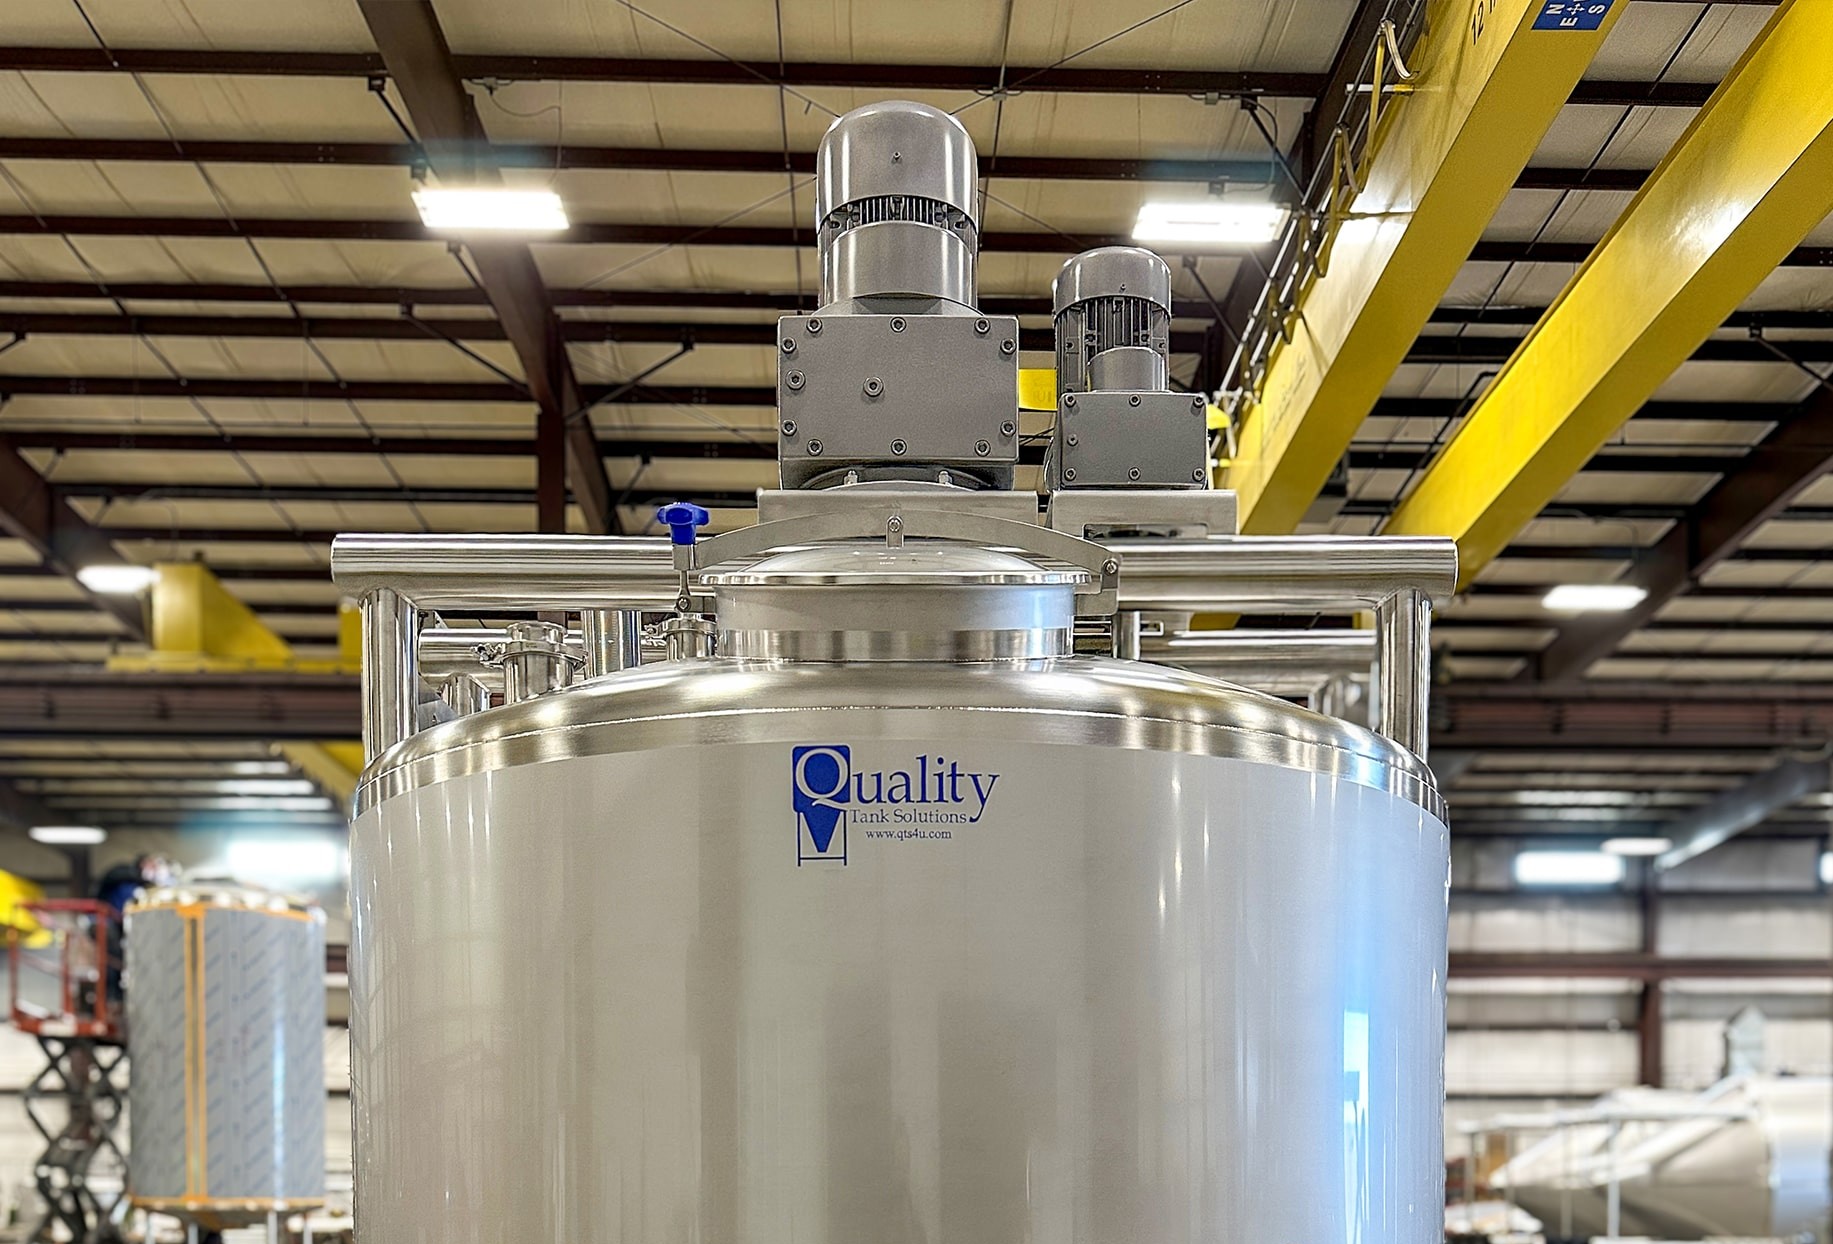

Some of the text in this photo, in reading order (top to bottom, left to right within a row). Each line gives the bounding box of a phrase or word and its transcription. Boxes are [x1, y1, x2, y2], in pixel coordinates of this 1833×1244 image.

[1546, 4, 1565, 14] N
[1588, 4, 1605, 14] S
[1560, 17, 1578, 26] E
[795, 747, 1000, 822] Quality
[850, 808, 967, 823] Tank Solutions
[866, 828, 952, 840] www.qts4u.com
